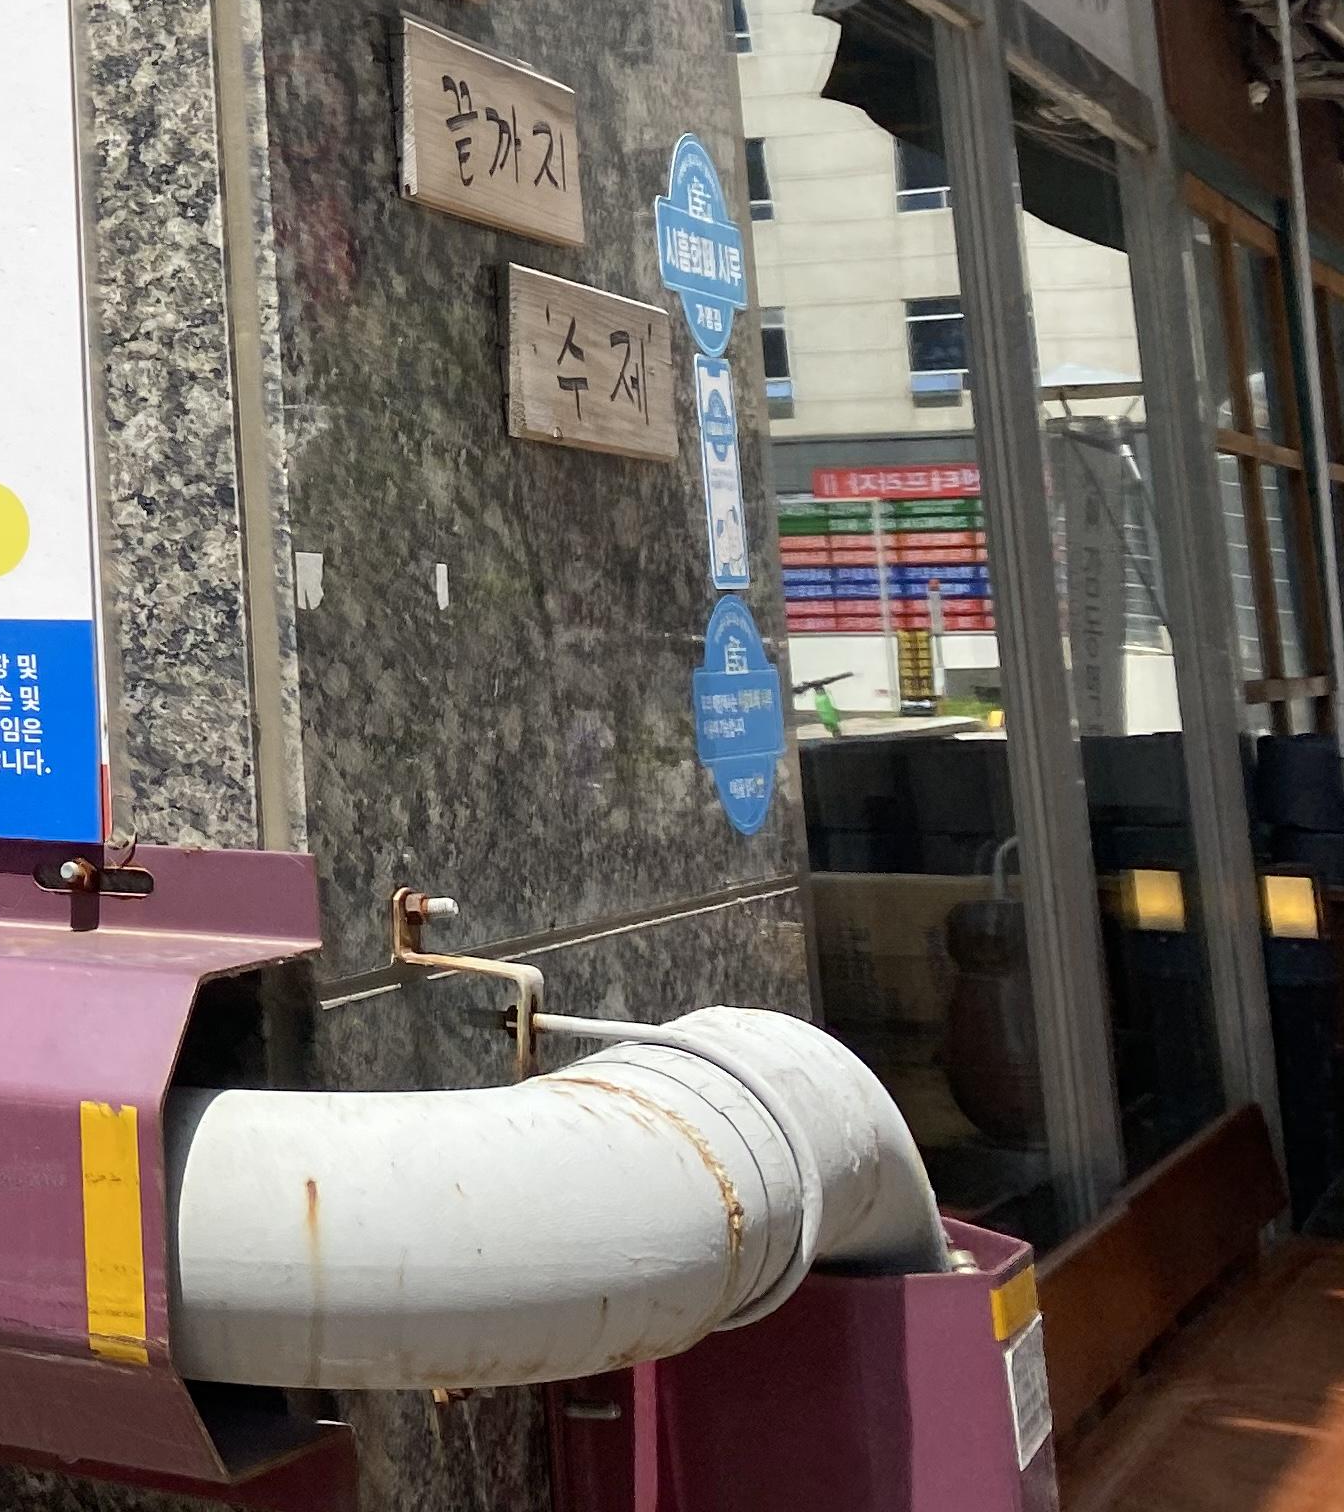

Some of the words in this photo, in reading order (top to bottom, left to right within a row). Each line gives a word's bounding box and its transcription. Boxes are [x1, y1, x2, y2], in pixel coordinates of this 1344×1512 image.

[440, 74, 567, 193] 끝까지
[16, 653, 38, 680] 및
[19, 686, 41, 712] 및
